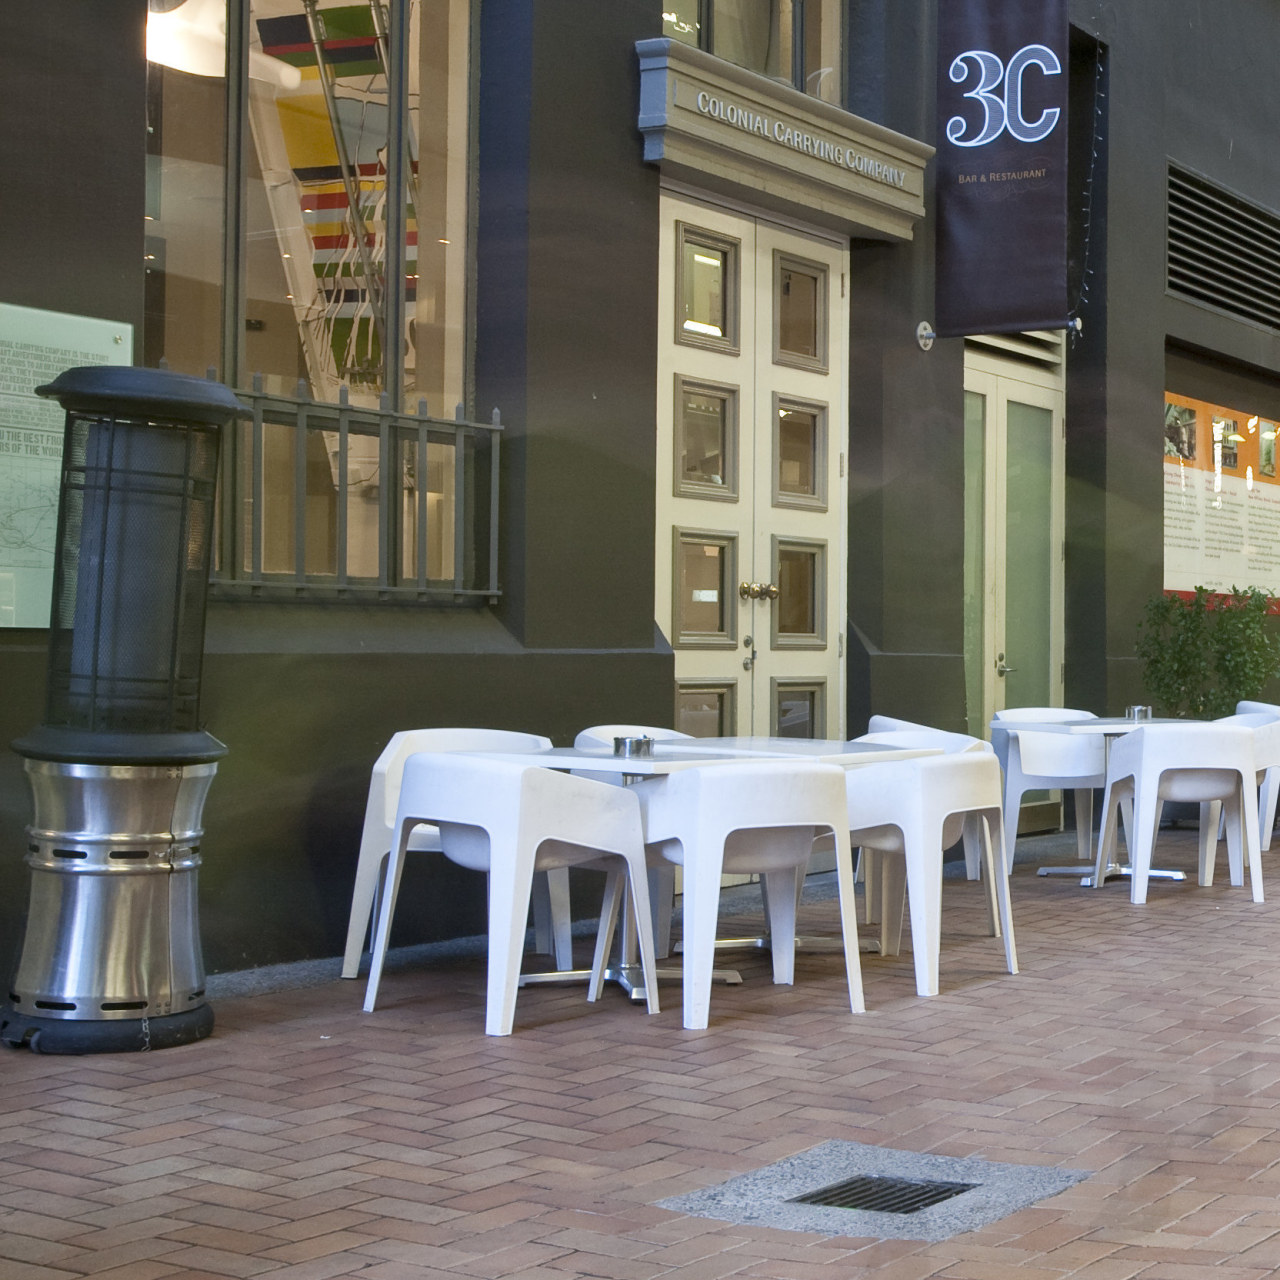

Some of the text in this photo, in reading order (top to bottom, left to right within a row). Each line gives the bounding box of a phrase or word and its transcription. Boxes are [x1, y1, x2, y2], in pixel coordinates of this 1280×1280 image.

[946, 44, 1062, 148] 3C
[697, 91, 906, 187] COLONIAL CARRYING COMPANY
[958, 168, 1047, 184] BAR & RESTAURANT
[46, 435, 64, 447] FRO
[41, 446, 63, 458] WORL
